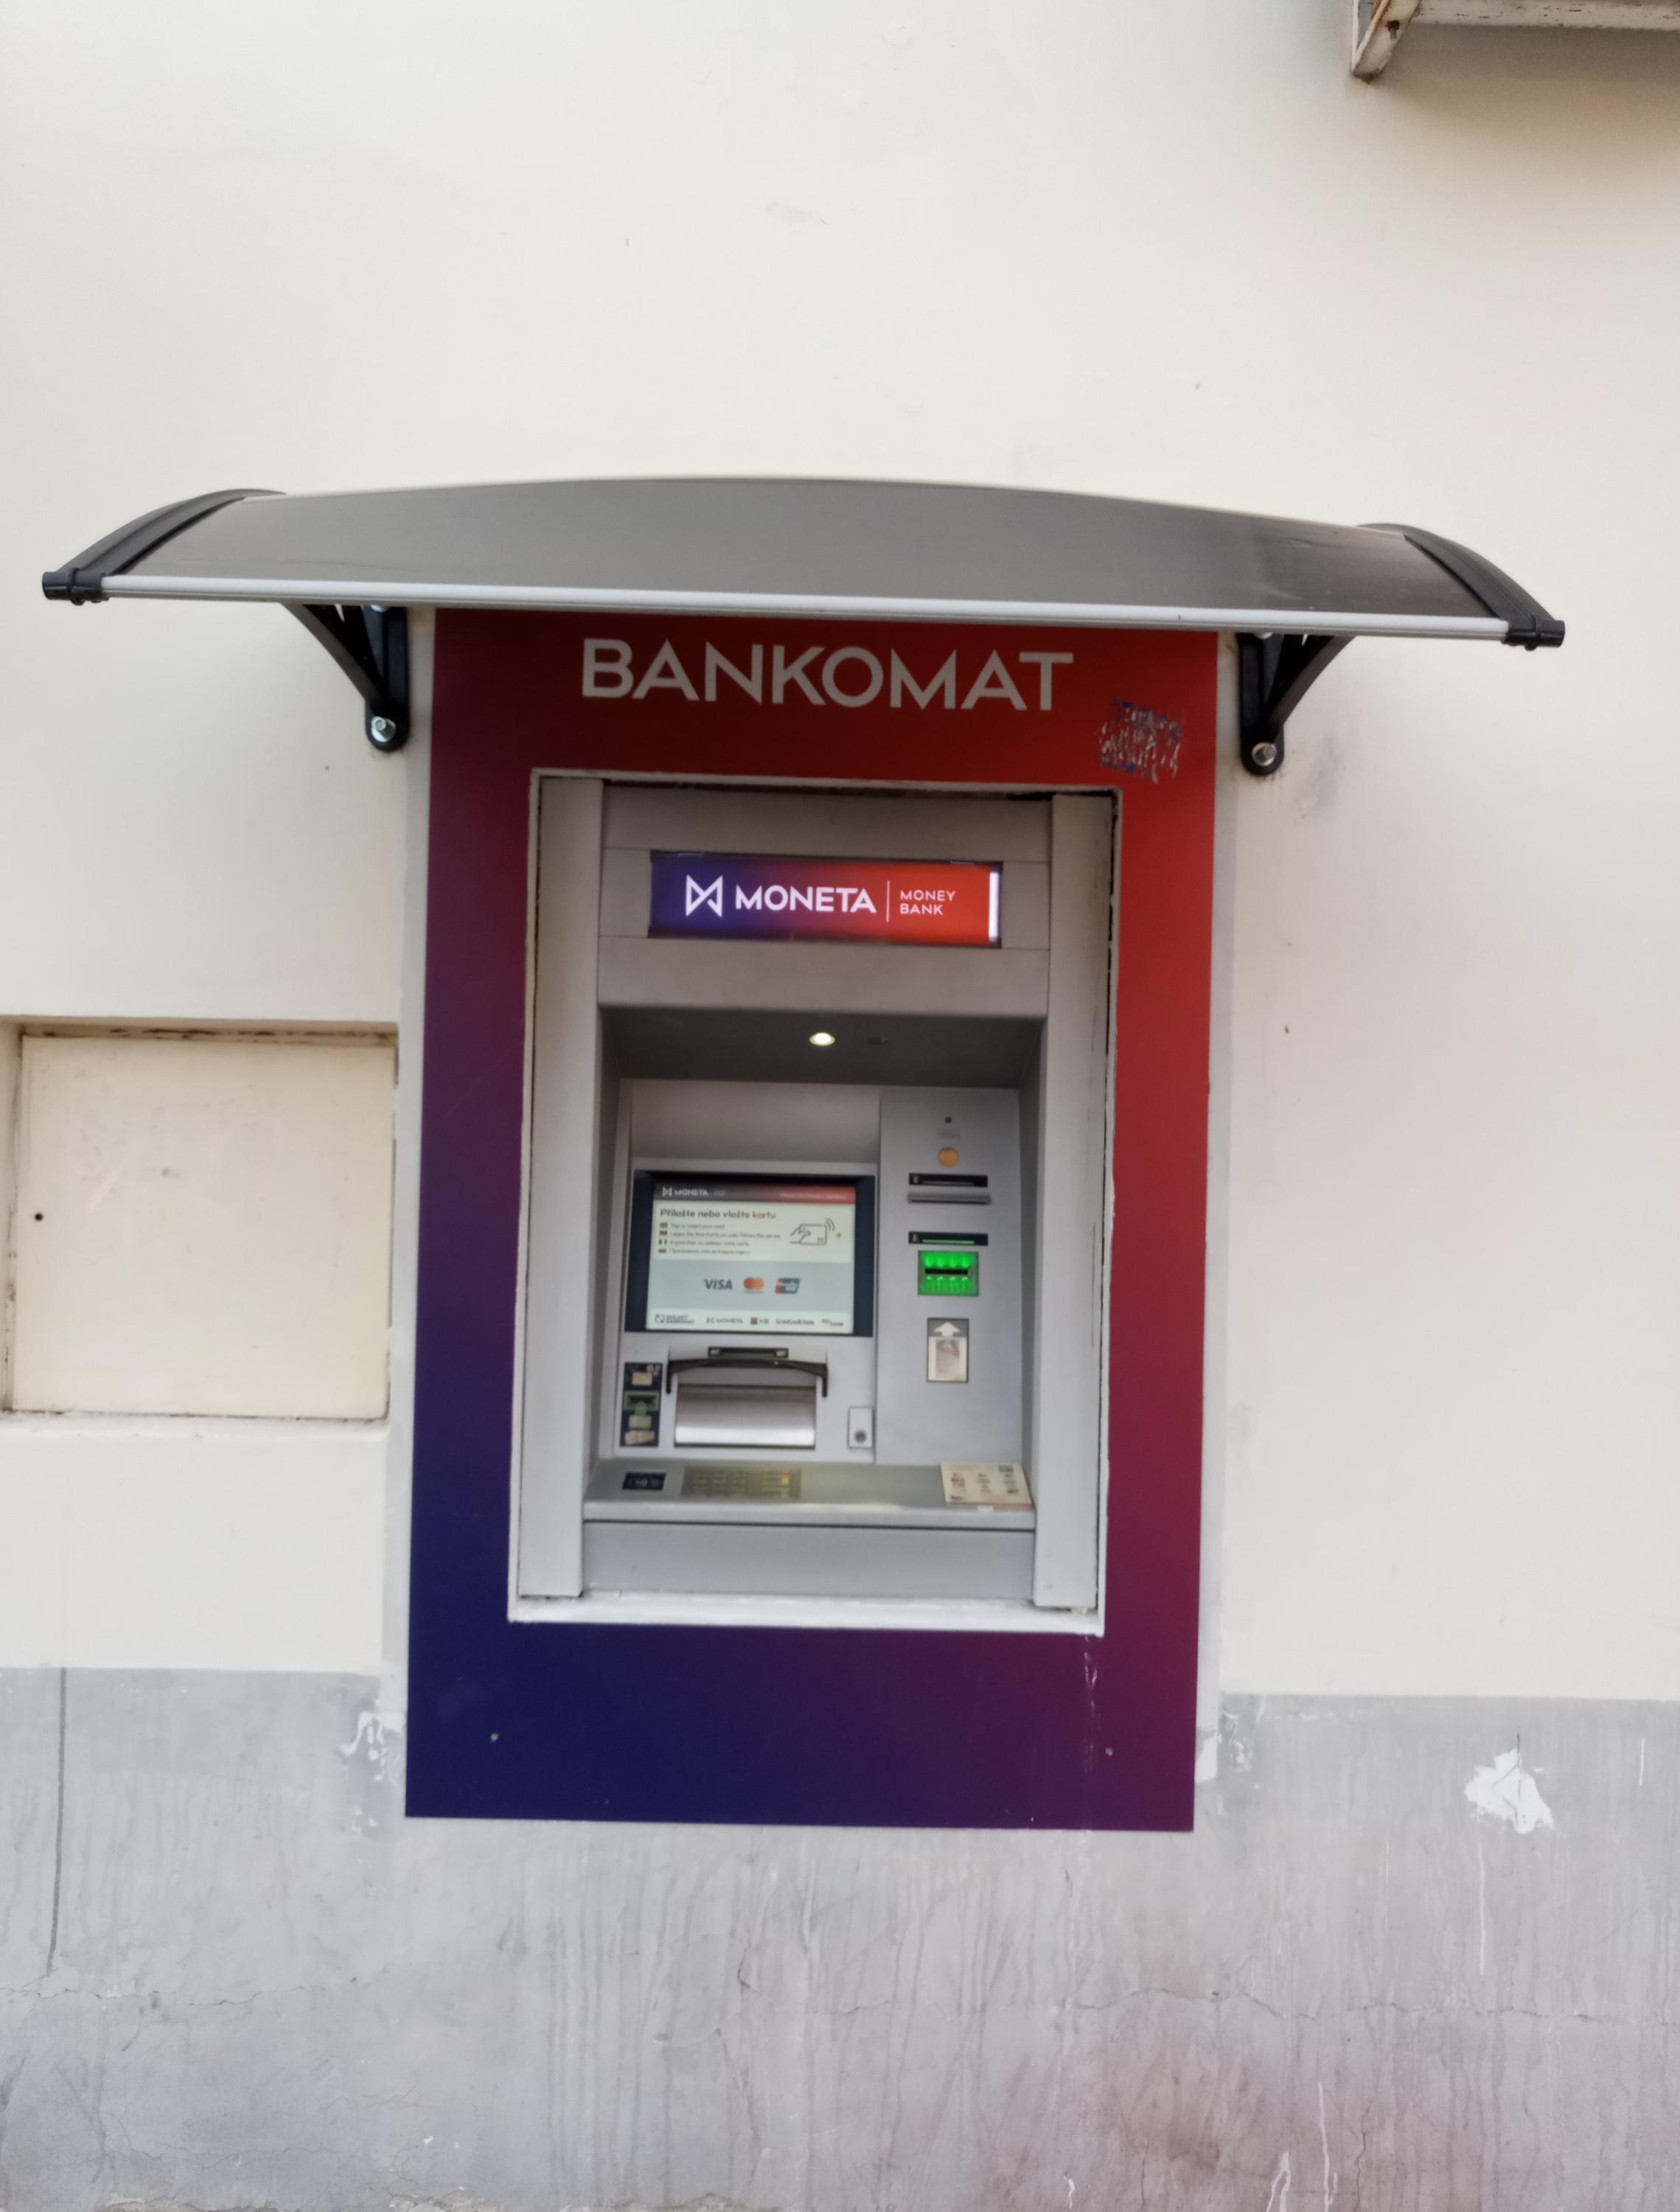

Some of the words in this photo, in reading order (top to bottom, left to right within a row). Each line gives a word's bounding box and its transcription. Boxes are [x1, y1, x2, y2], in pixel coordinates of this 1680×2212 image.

[582, 638, 1074, 712] BANKOMAT
[735, 884, 877, 914] MONETA
[900, 889, 956, 902] MONEY
[899, 903, 944, 916] BANK
[674, 1188, 709, 1197] MONETA
[697, 1209, 721, 1218] nebo
[752, 1211, 777, 1220] kartu
[704, 1279, 733, 1290] VISA
